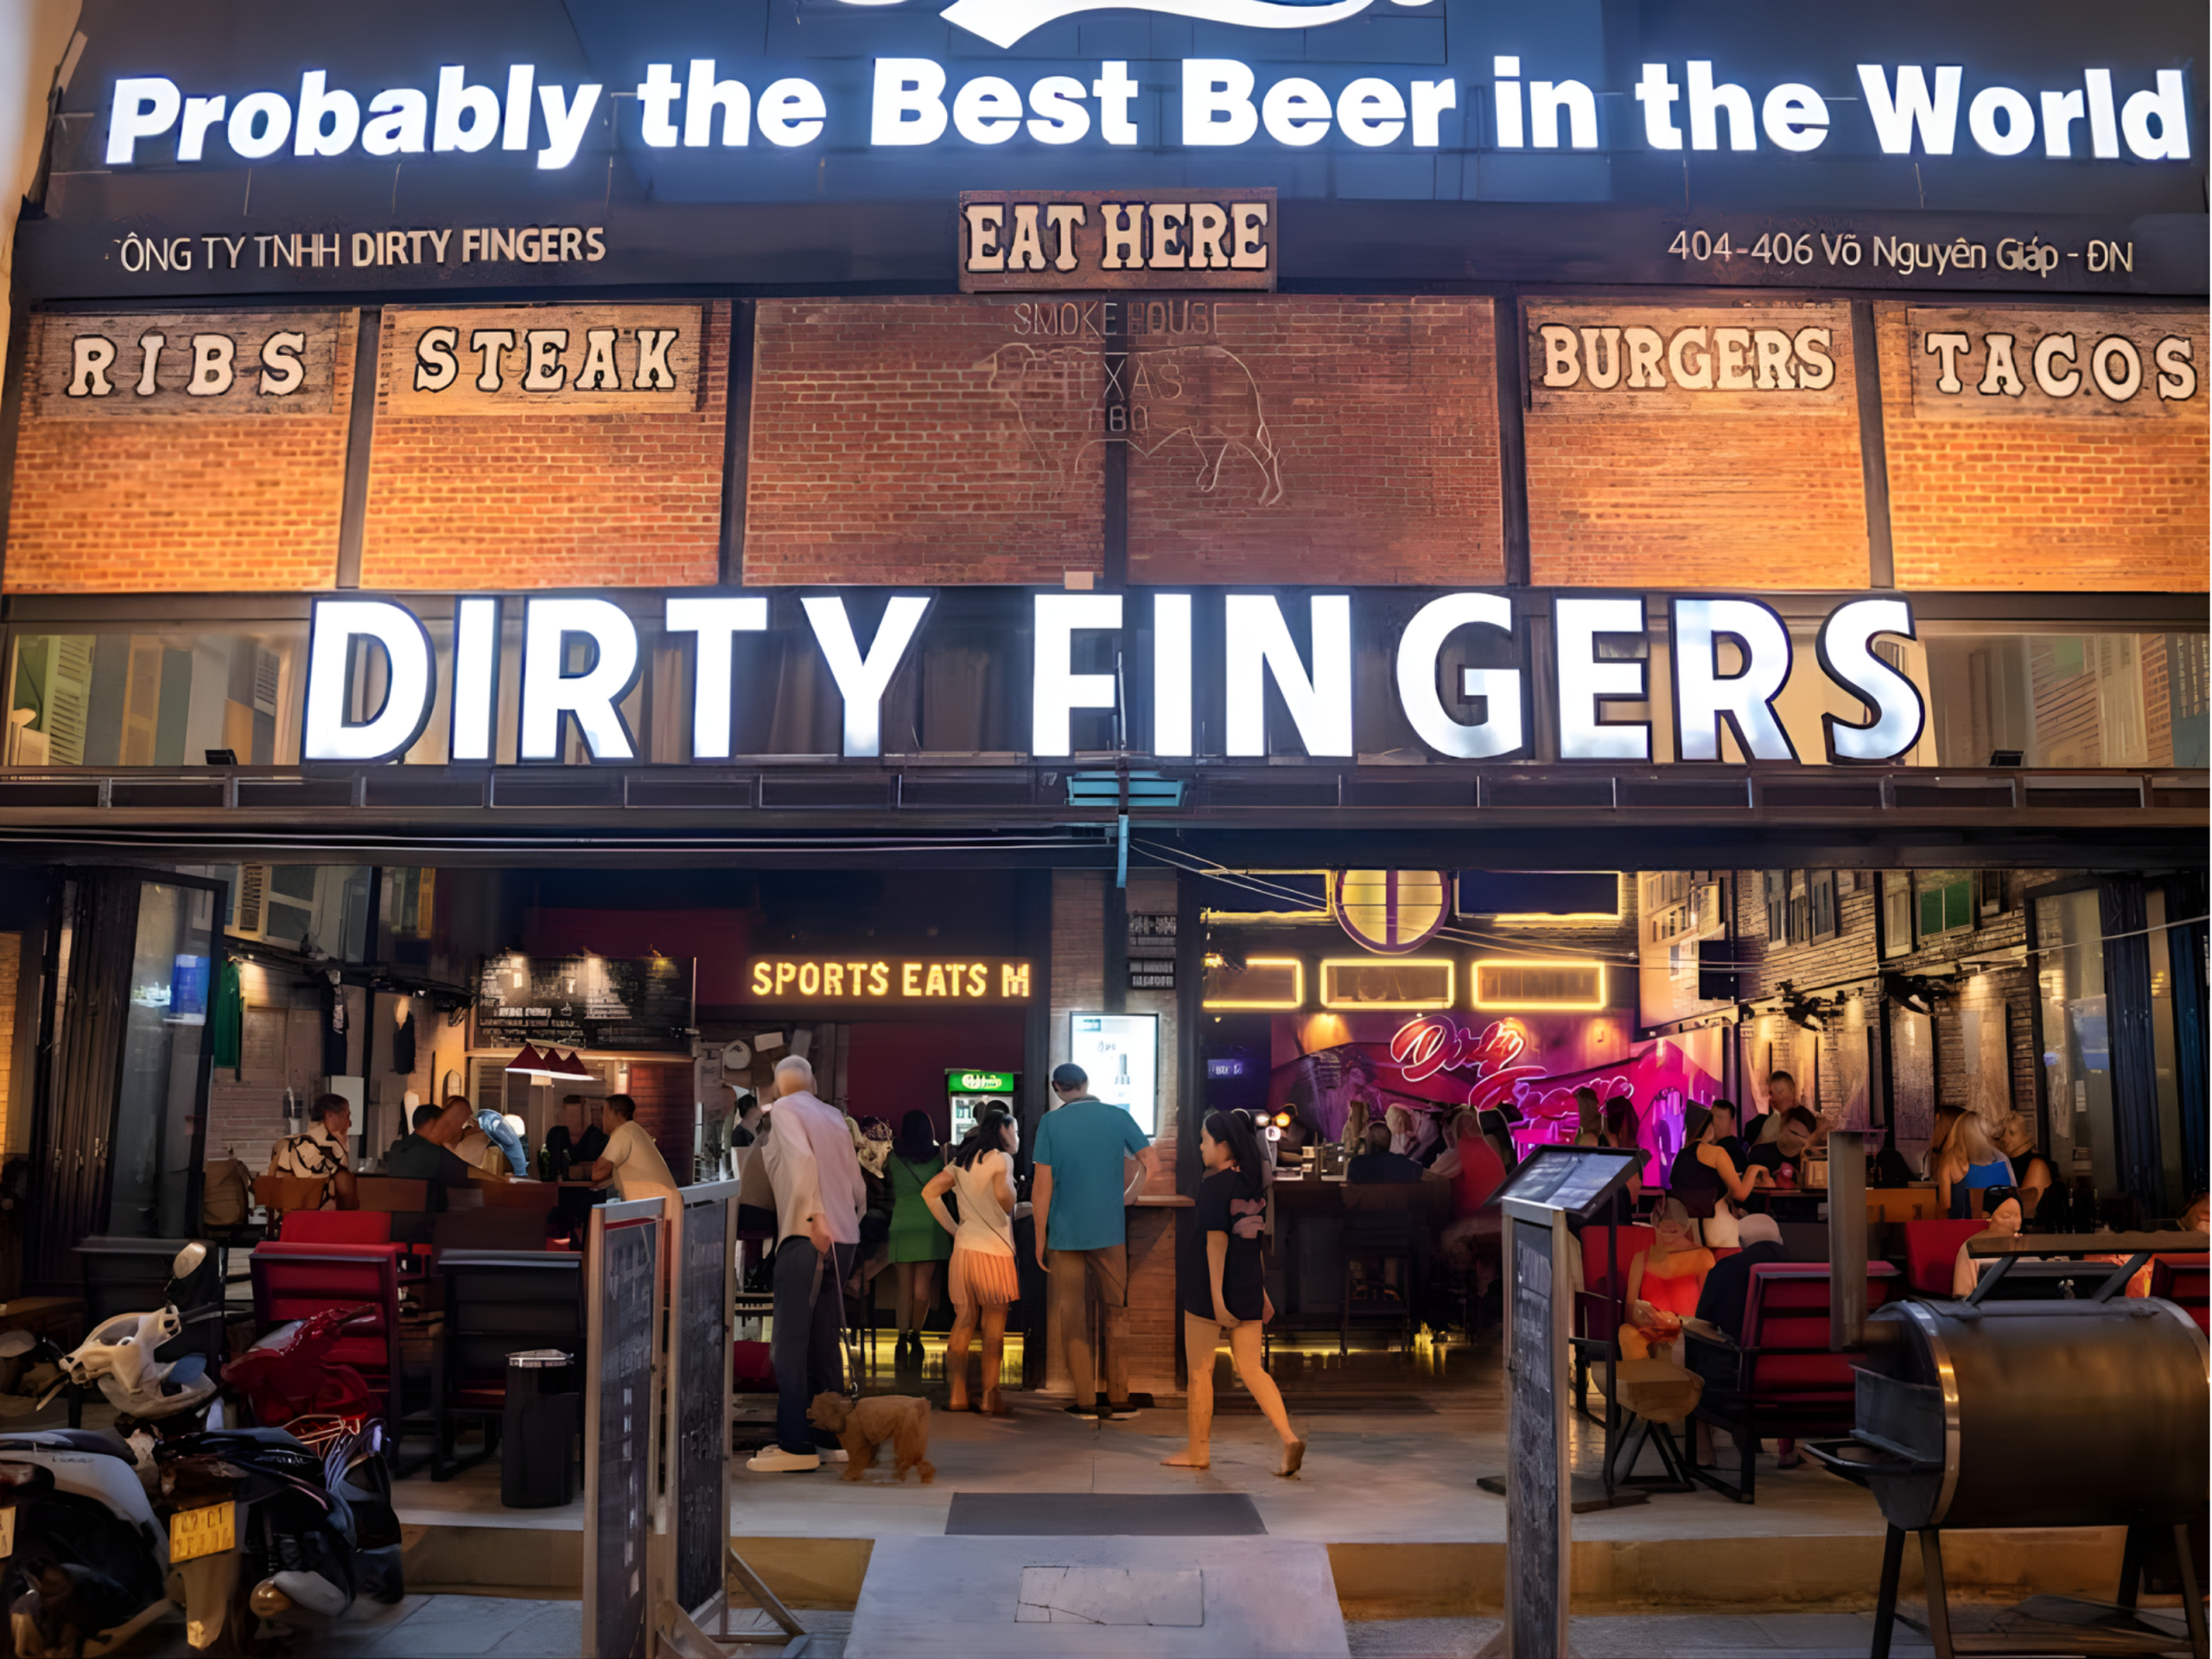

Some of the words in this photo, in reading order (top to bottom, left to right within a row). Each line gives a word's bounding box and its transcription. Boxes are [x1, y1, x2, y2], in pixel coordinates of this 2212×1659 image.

[105, 64, 602, 169] Probably
[637, 59, 827, 147] the
[870, 58, 1139, 146] Best
[1181, 58, 1456, 147] Beer
[1493, 55, 1599, 149] in
[1635, 60, 1830, 152] the
[1857, 64, 2191, 160] World
[105, 231, 192, 272] ÔNG
[200, 235, 247, 270] TY
[253, 232, 340, 269] TNHH
[352, 228, 453, 267] DIRTY
[462, 226, 607, 264] FINGERS
[964, 202, 1087, 273] EAT
[1099, 201, 1269, 271] HERE
[1667, 229, 1815, 265] 404-406
[1820, 232, 1862, 266] Võ
[1014, 301, 1118, 338] SMOKE
[66, 330, 307, 399] RIBS
[413, 326, 681, 393] STEAK
[1539, 323, 1836, 391] BURGERS
[1924, 332, 2199, 403] TACOS
[304, 594, 934, 763] DIRTY
[1031, 591, 1928, 766] FINGERS
[751, 961, 890, 996] SPORTS
[902, 962, 988, 997] EATS
